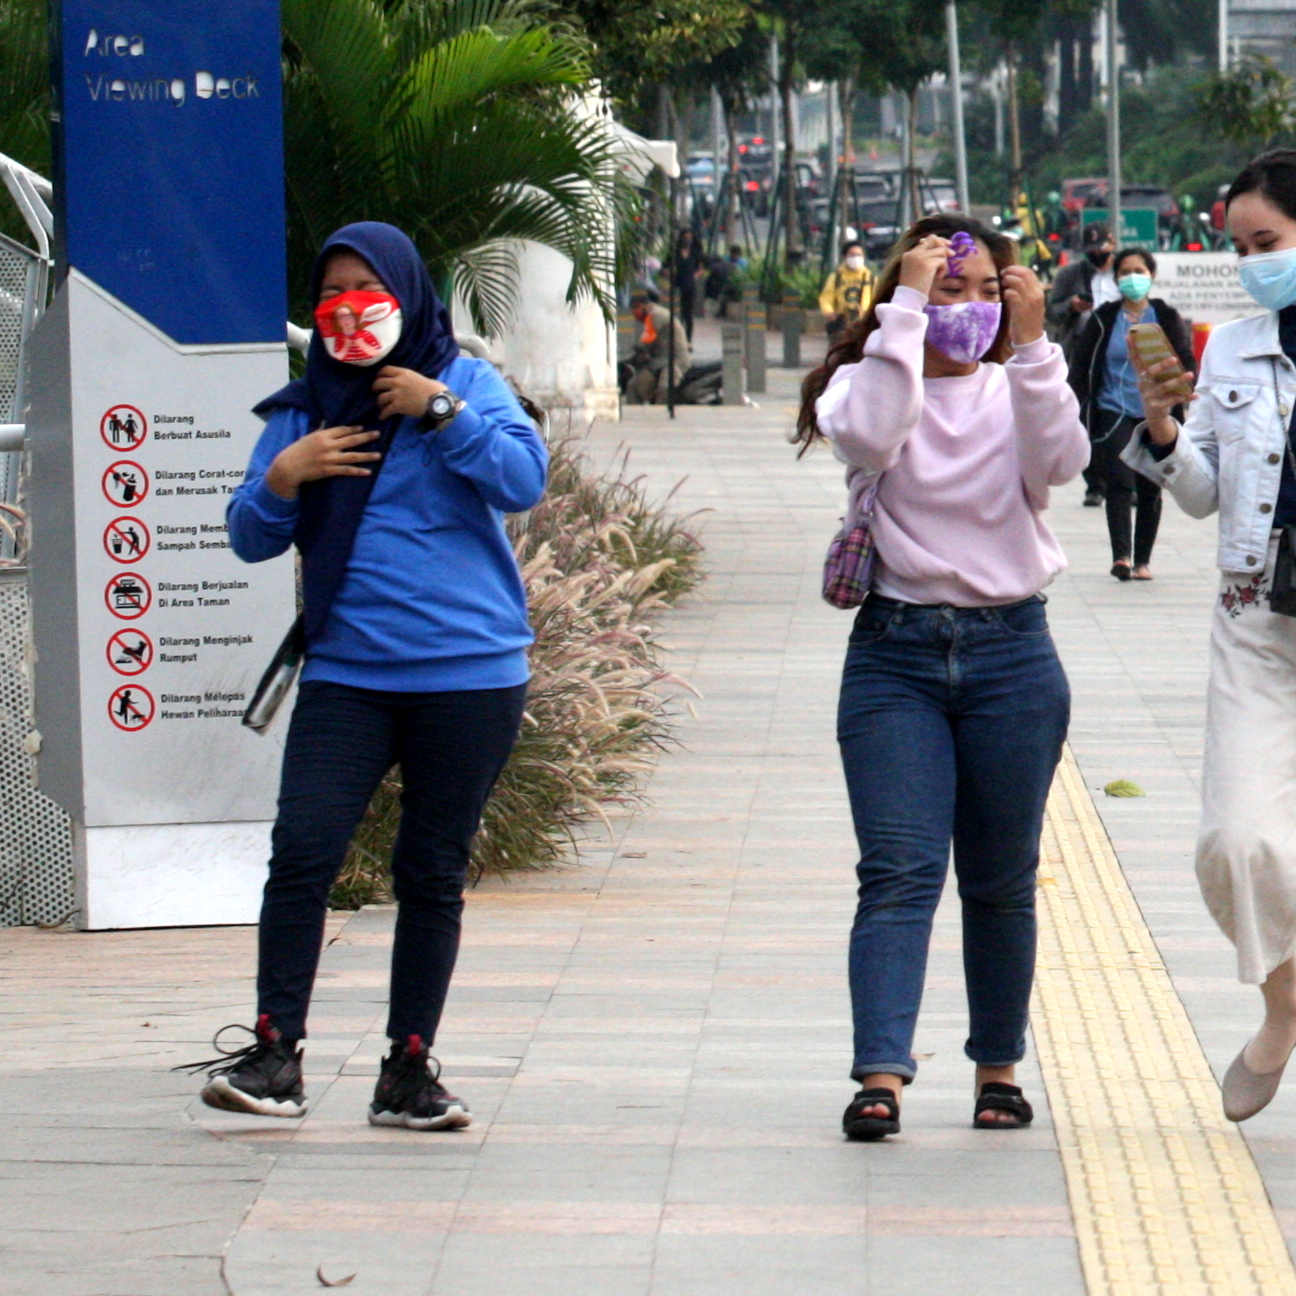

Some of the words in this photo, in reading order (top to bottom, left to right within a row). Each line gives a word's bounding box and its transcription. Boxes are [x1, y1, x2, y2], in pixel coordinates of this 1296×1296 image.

[84, 28, 145, 56] Area
[85, 73, 186, 107] Viewing
[196, 71, 260, 99] Deck
[153, 415, 194, 425] Dilarang
[154, 431, 192, 440] Berbuat
[195, 429, 231, 439] Asusila
[155, 470, 196, 481] Dilarang
[199, 469, 245, 478] Corat-cor
[155, 487, 173, 496] dan
[176, 486, 218, 495] Merusak
[156, 525, 197, 535] Dilarang
[200, 524, 229, 533] Memb
[157, 541, 196, 552] Sampah
[158, 582, 199, 592] Dilarang
[202, 580, 248, 591] Berjualan
[159, 598, 168, 608] Di
[171, 598, 194, 607] Area
[197, 597, 230, 606] Taman
[160, 637, 200, 647] Dilarang
[203, 634, 253, 646] Menginjak
[160, 653, 197, 663] Rumput
[161, 694, 201, 704] Dilarang
[204, 692, 245, 702] Melepas
[161, 710, 194, 719] Hewan
[197, 708, 245, 718] Peliharaa
